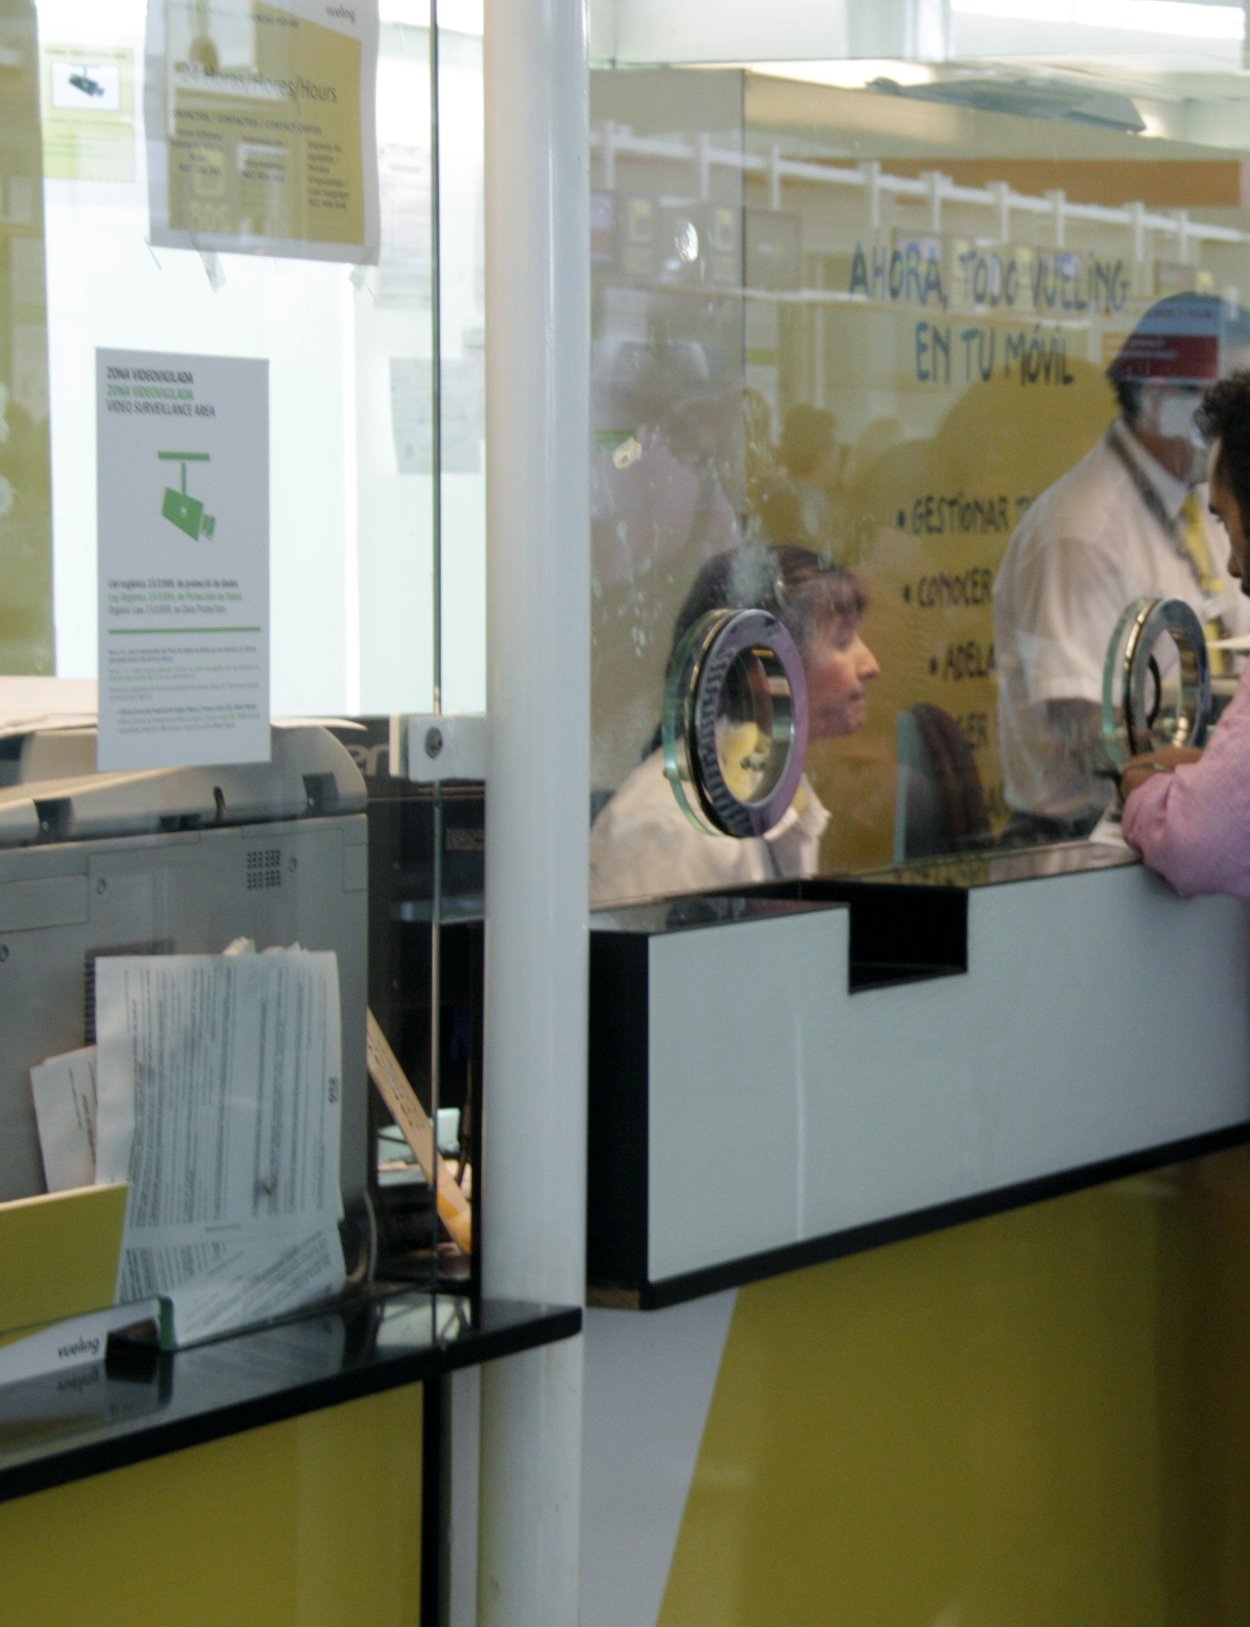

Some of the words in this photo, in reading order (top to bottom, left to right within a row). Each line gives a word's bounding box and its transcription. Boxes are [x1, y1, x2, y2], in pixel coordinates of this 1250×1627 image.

[915, 320, 951, 384] EN
[960, 326, 997, 383] TU
[107, 366, 130, 380] ZONA
[132, 368, 194, 384] VIDEOVIGILADA
[107, 384, 130, 397] ZONA
[132, 386, 194, 400] VIDEOVIGILADA
[107, 400, 131, 414] VIDEO
[134, 401, 193, 416] SURVEILLANCE
[194, 404, 216, 417] AREA
[917, 567, 993, 608] CONOCER
